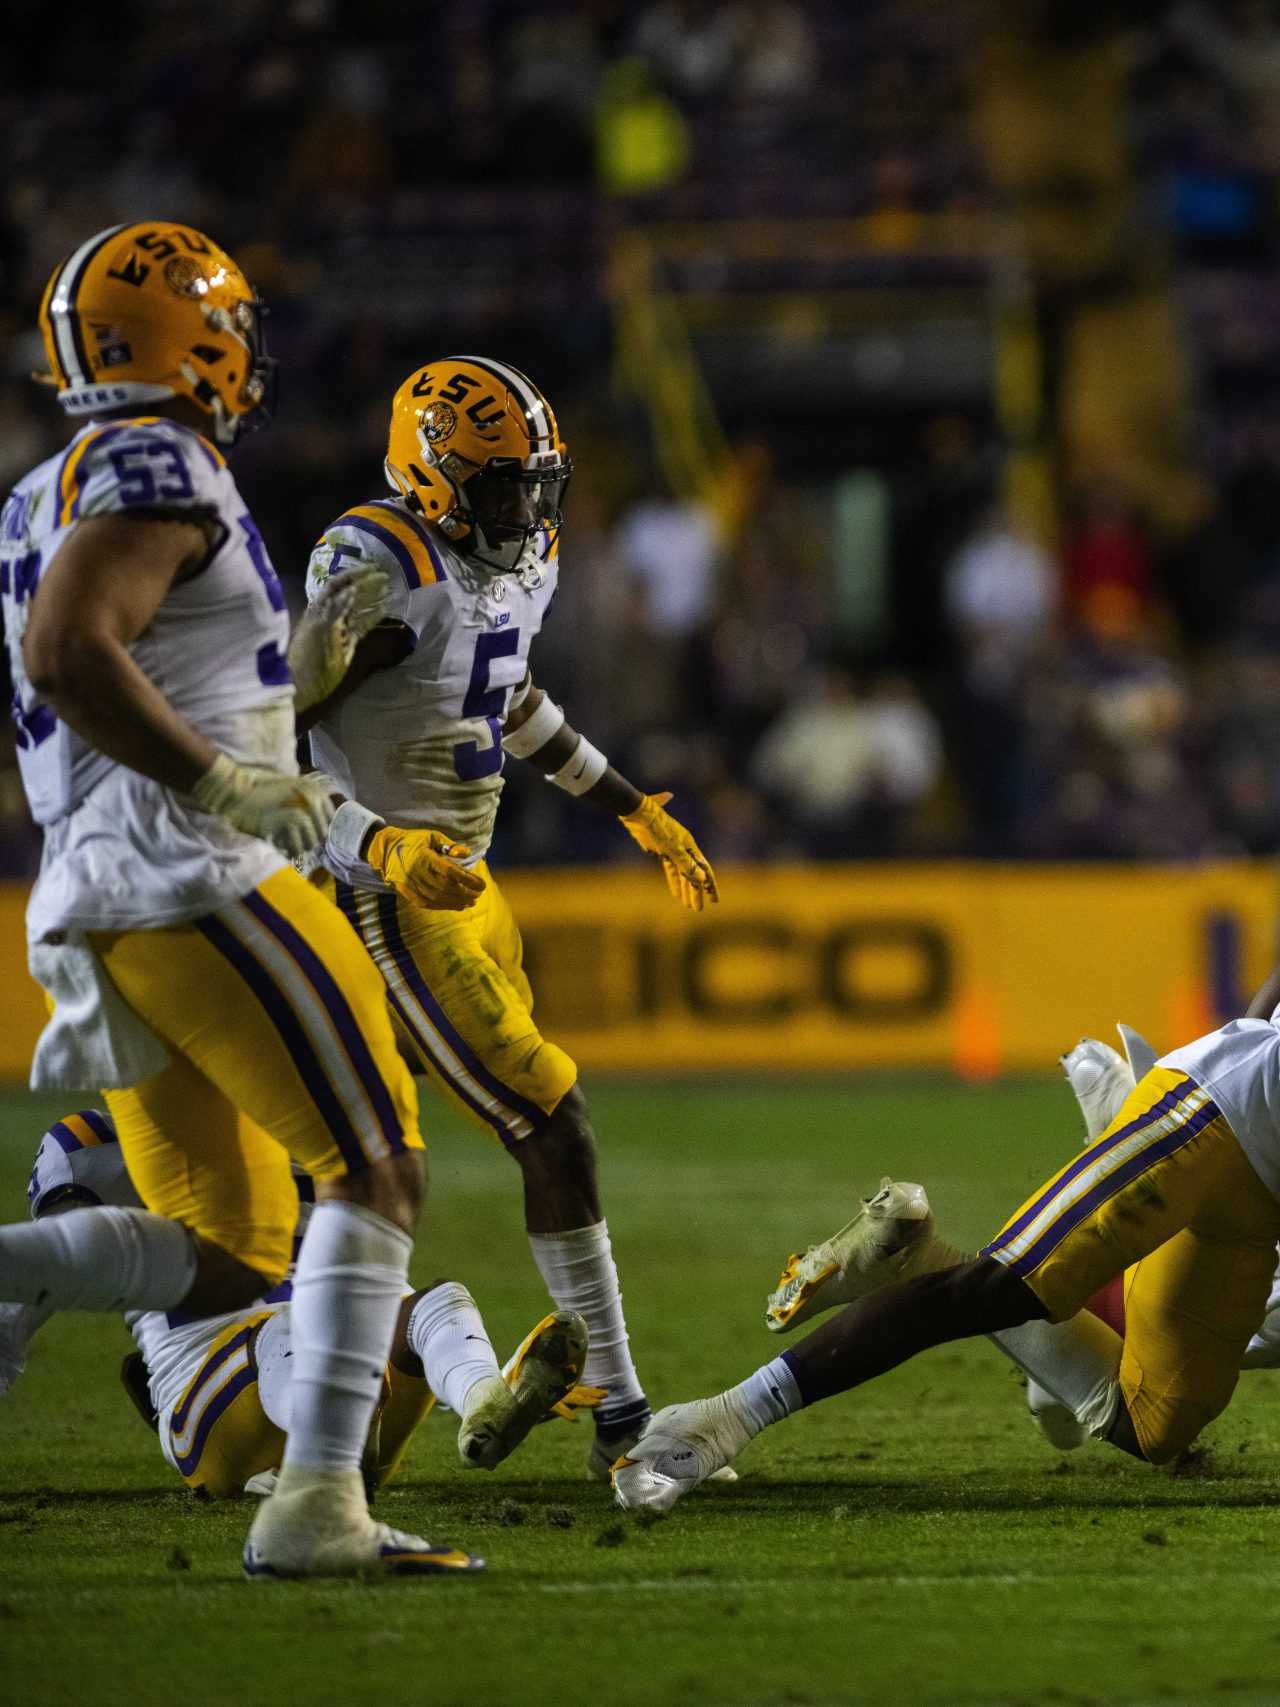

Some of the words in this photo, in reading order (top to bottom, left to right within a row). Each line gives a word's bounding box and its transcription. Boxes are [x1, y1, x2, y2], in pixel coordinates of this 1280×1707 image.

[107, 231, 210, 287] LSU
[412, 372, 505, 430] LSU
[108, 442, 195, 505] 53
[453, 628, 520, 781] 5
[521, 919, 952, 1021] EICO
